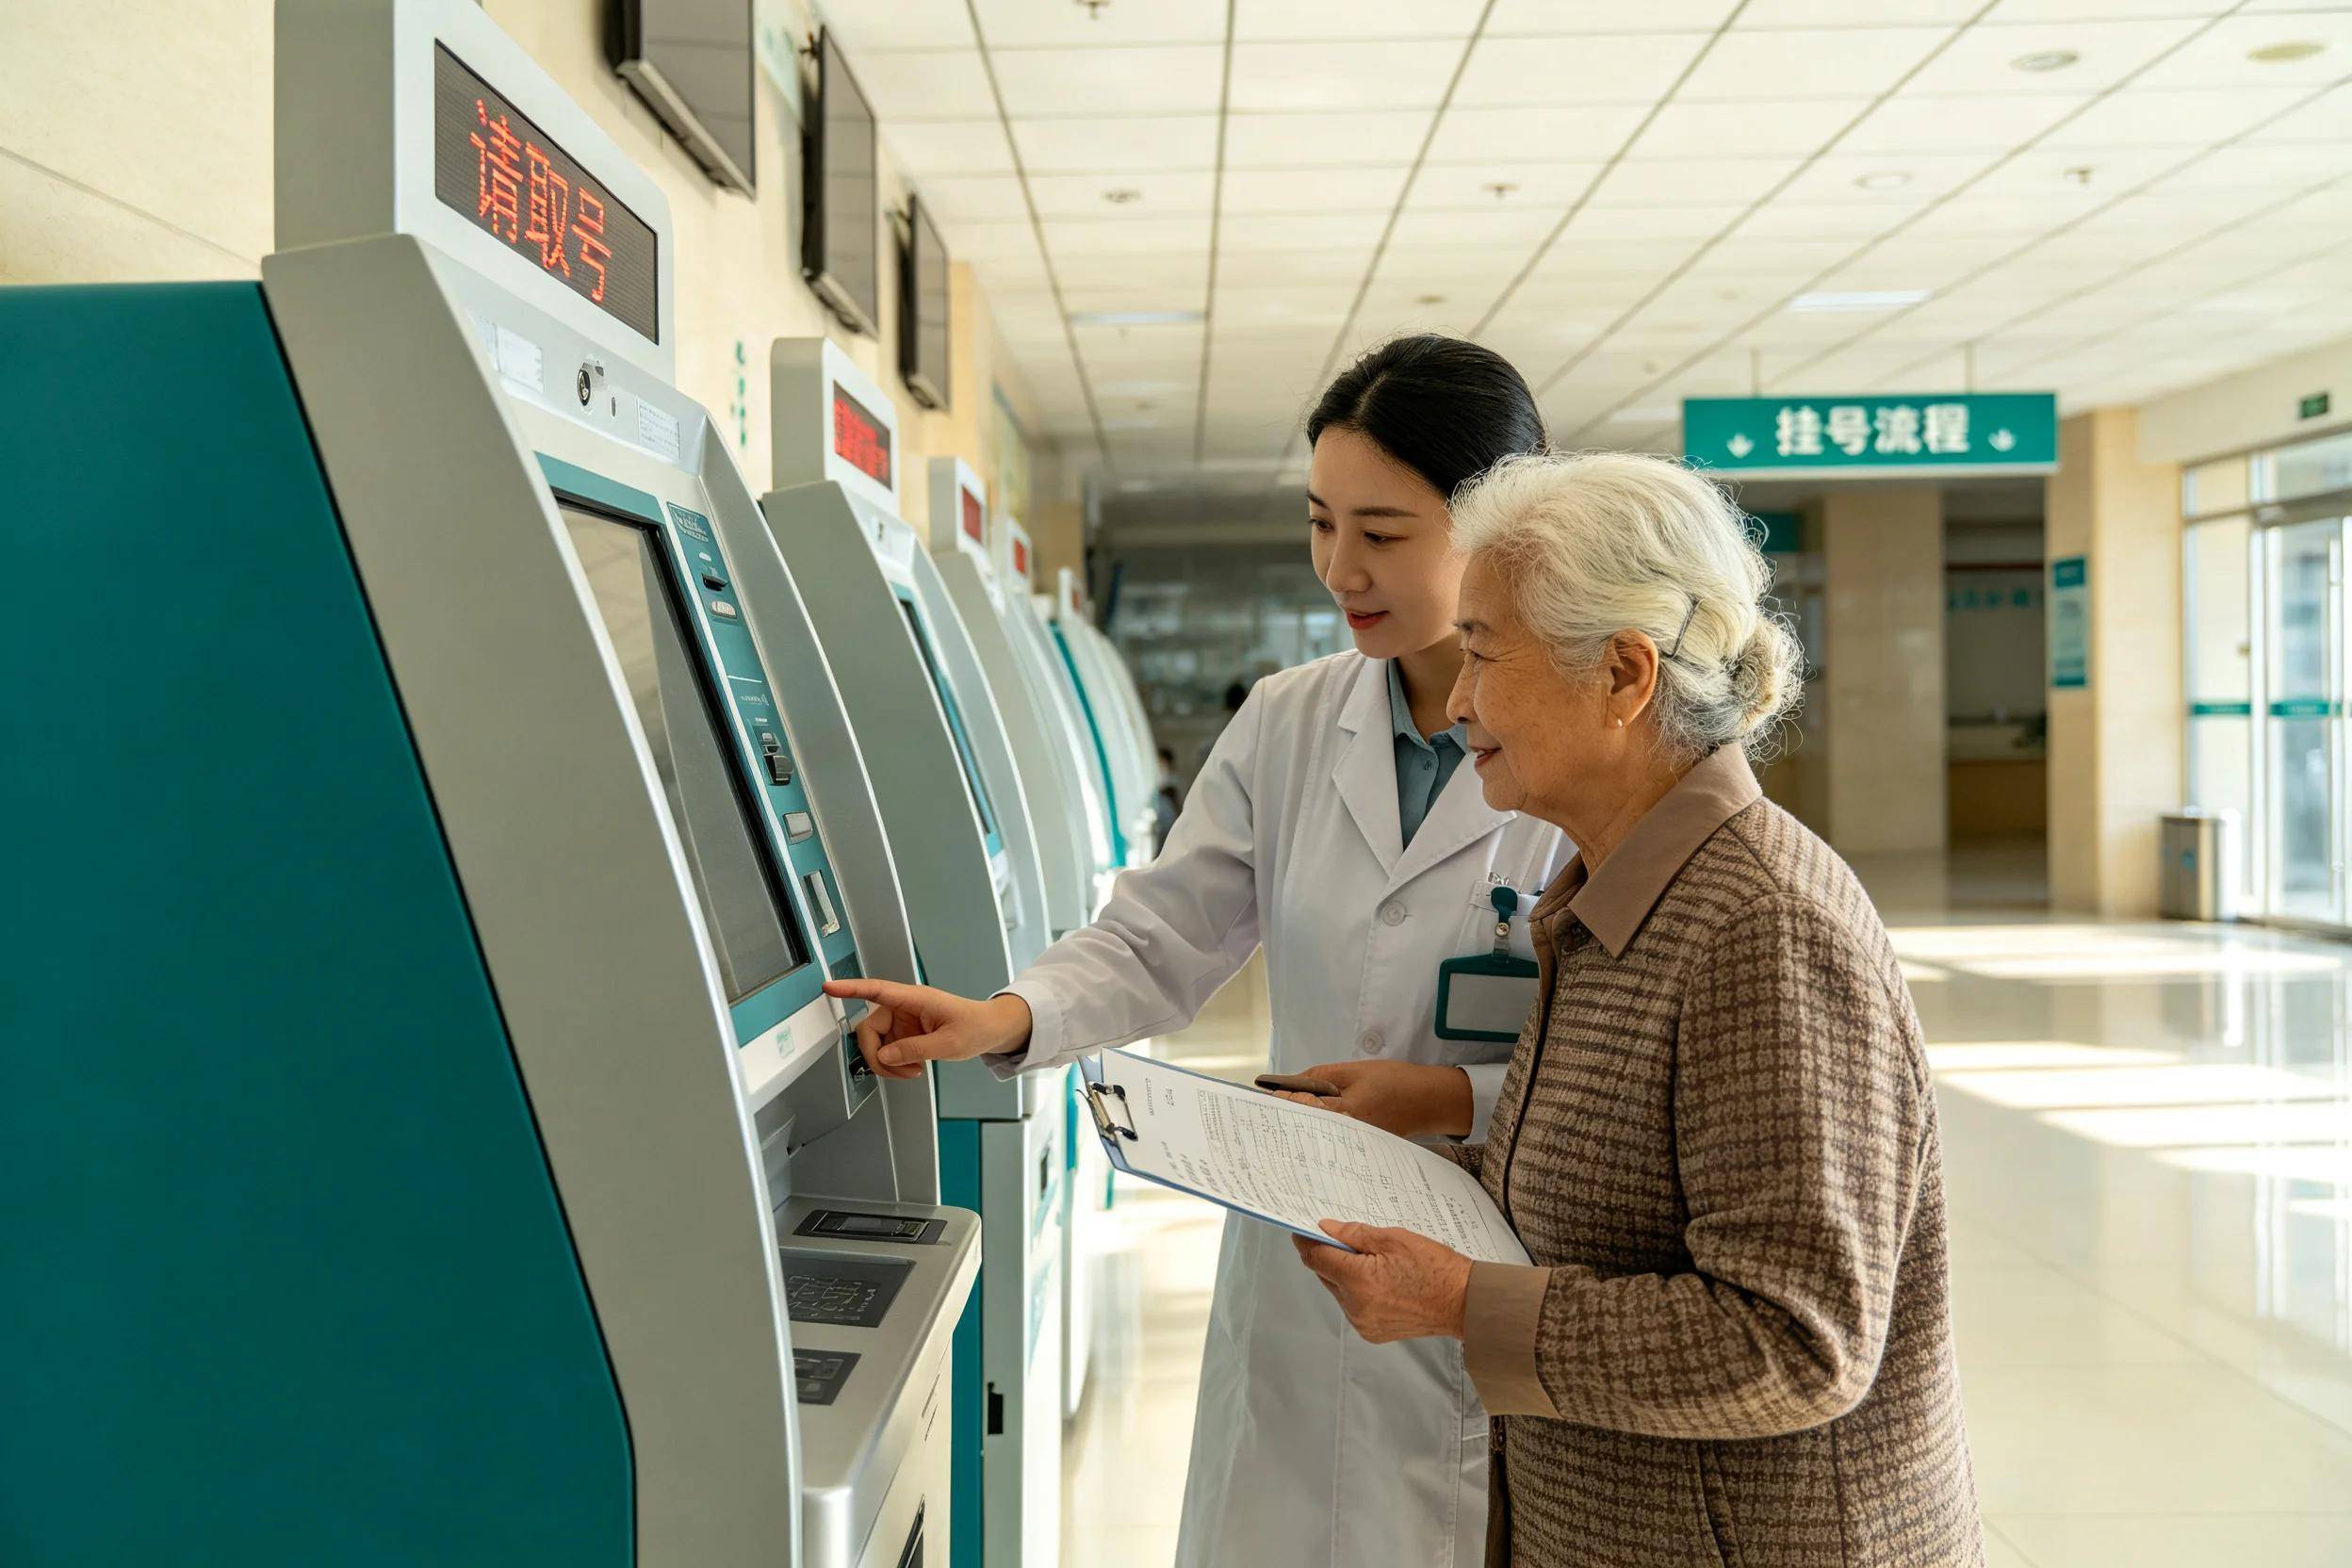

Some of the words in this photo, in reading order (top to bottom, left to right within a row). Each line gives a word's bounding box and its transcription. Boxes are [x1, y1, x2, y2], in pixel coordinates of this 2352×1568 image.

[469, 98, 612, 302] 请取号
[1775, 403, 1969, 456] 挂号流程
